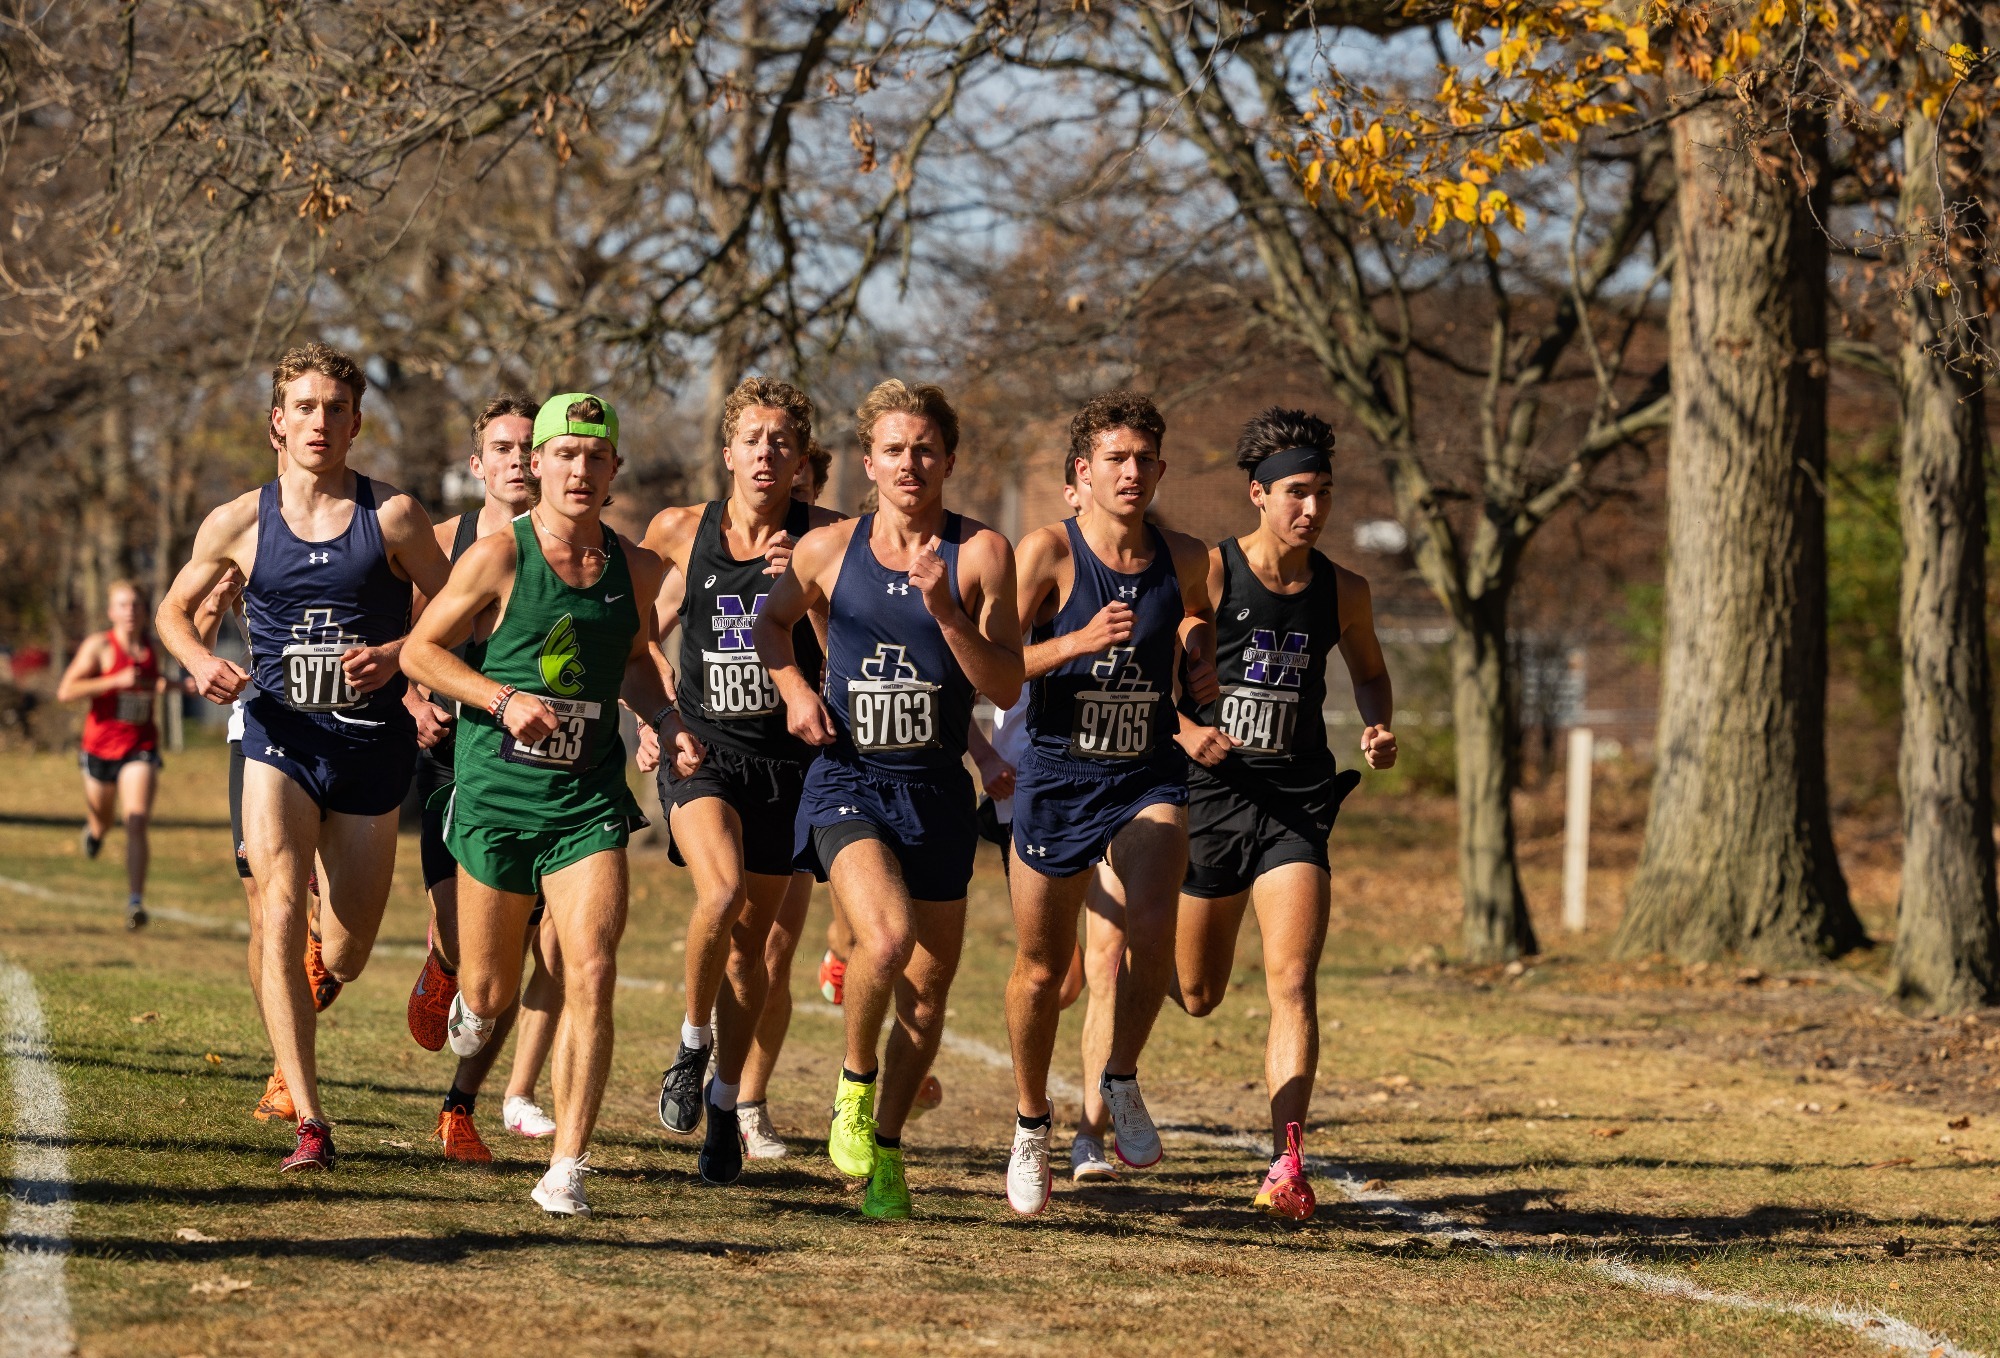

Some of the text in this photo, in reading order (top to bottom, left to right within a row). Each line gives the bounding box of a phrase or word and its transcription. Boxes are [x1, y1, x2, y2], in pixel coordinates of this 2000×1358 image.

[710, 664, 780, 711] 9839
[514, 716, 585, 759] 253
[856, 692, 932, 745] 9763
[1080, 702, 1150, 752] 9765
[1220, 696, 1287, 749] 9841
